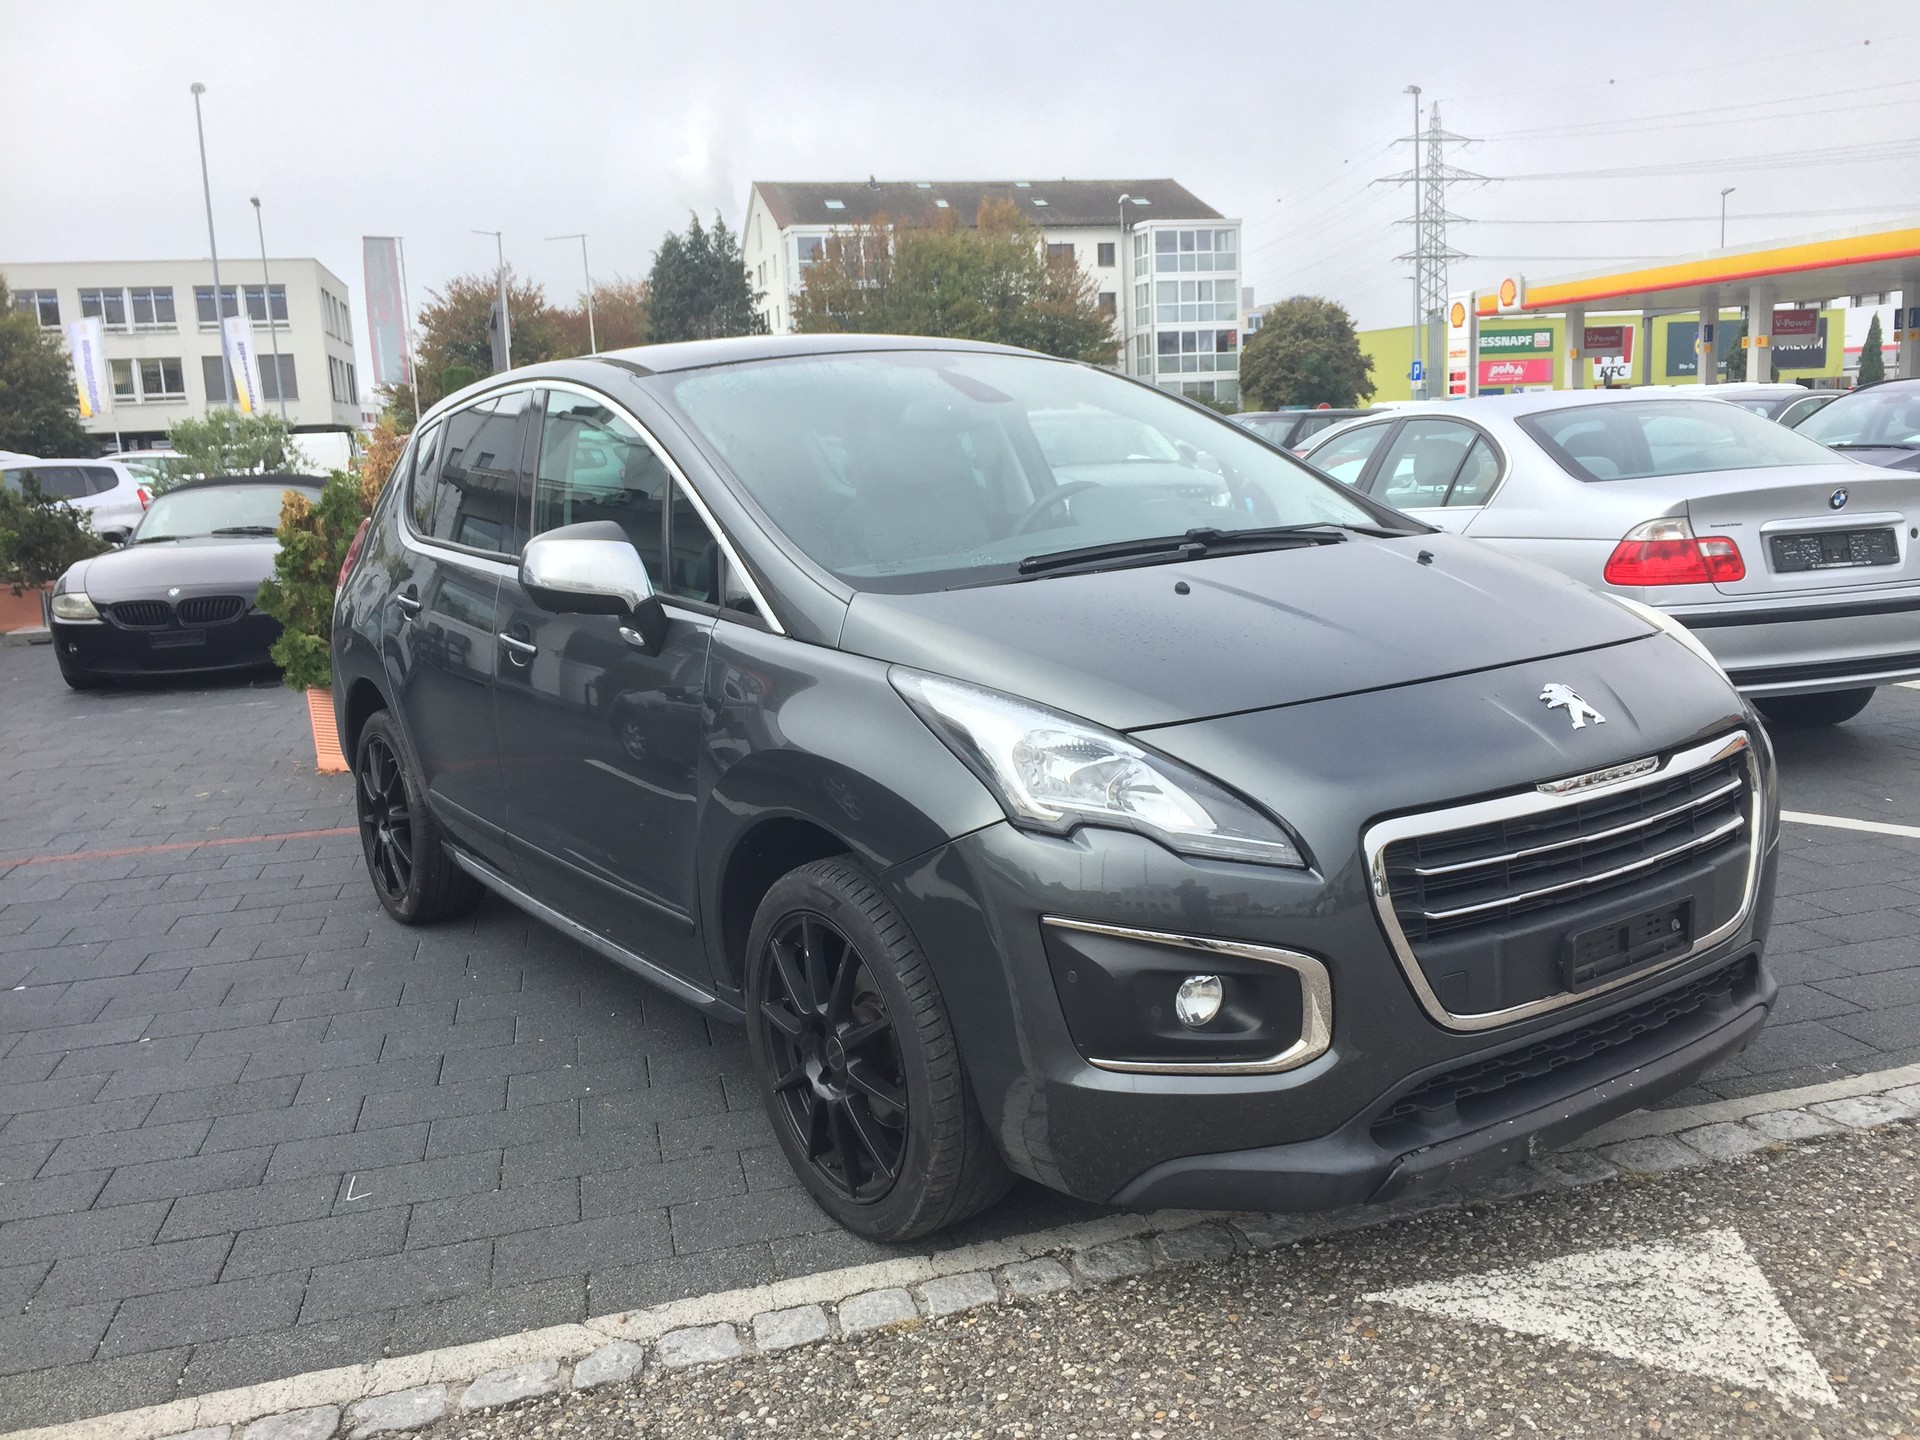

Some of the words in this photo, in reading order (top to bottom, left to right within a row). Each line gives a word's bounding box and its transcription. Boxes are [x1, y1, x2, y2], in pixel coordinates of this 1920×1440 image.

[1775, 318, 1813, 328] V-Power
[1413, 363, 1420, 380] P
[1599, 365, 1626, 378] KFC
